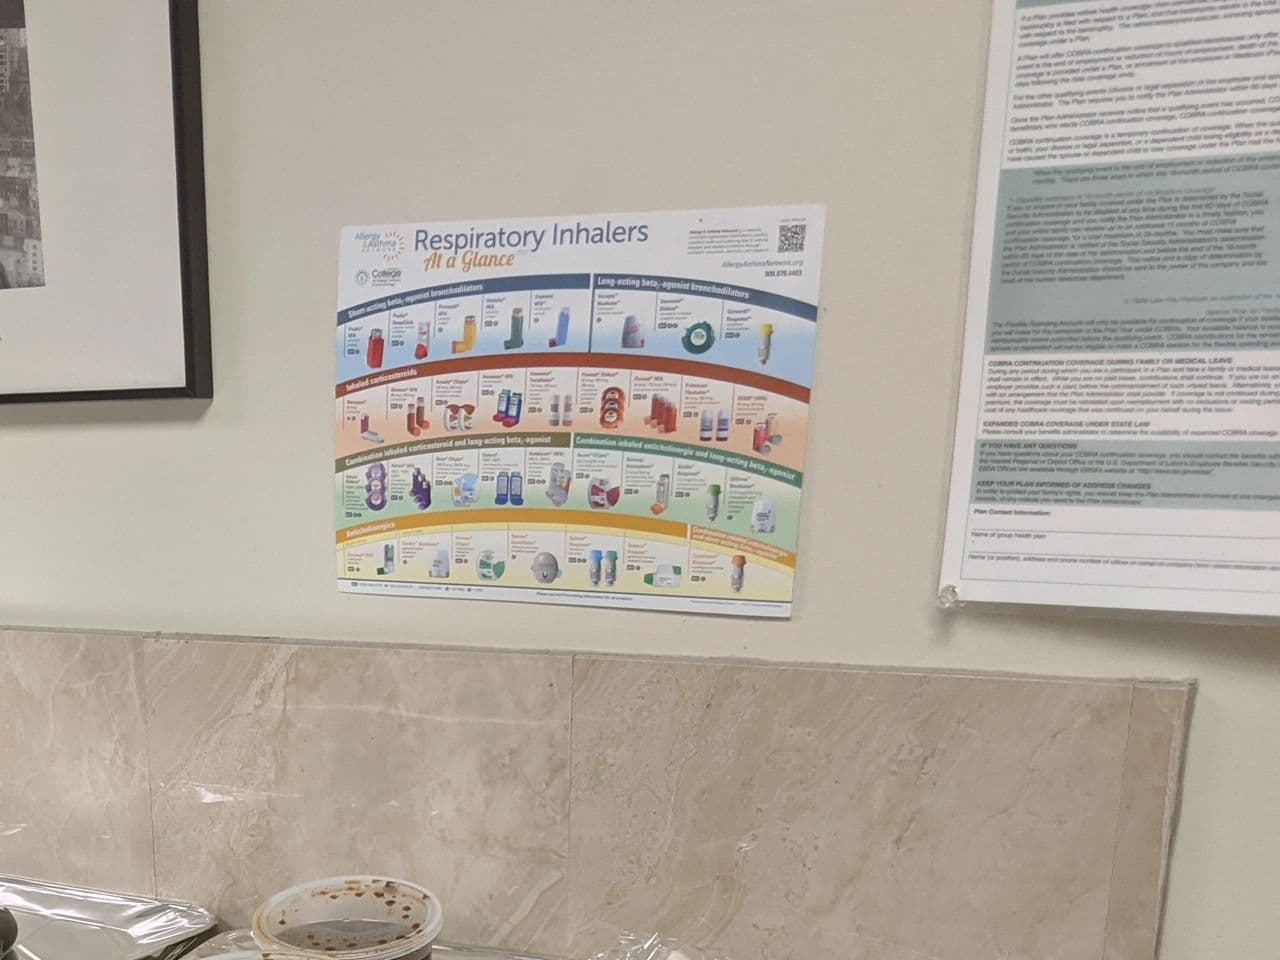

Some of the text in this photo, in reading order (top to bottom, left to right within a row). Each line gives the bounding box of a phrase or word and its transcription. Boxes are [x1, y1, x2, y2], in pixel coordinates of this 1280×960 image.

[415, 220, 649, 255] Respiratory Inhalers
[424, 250, 516, 272] At a Glance
[372, 268, 402, 279] College
